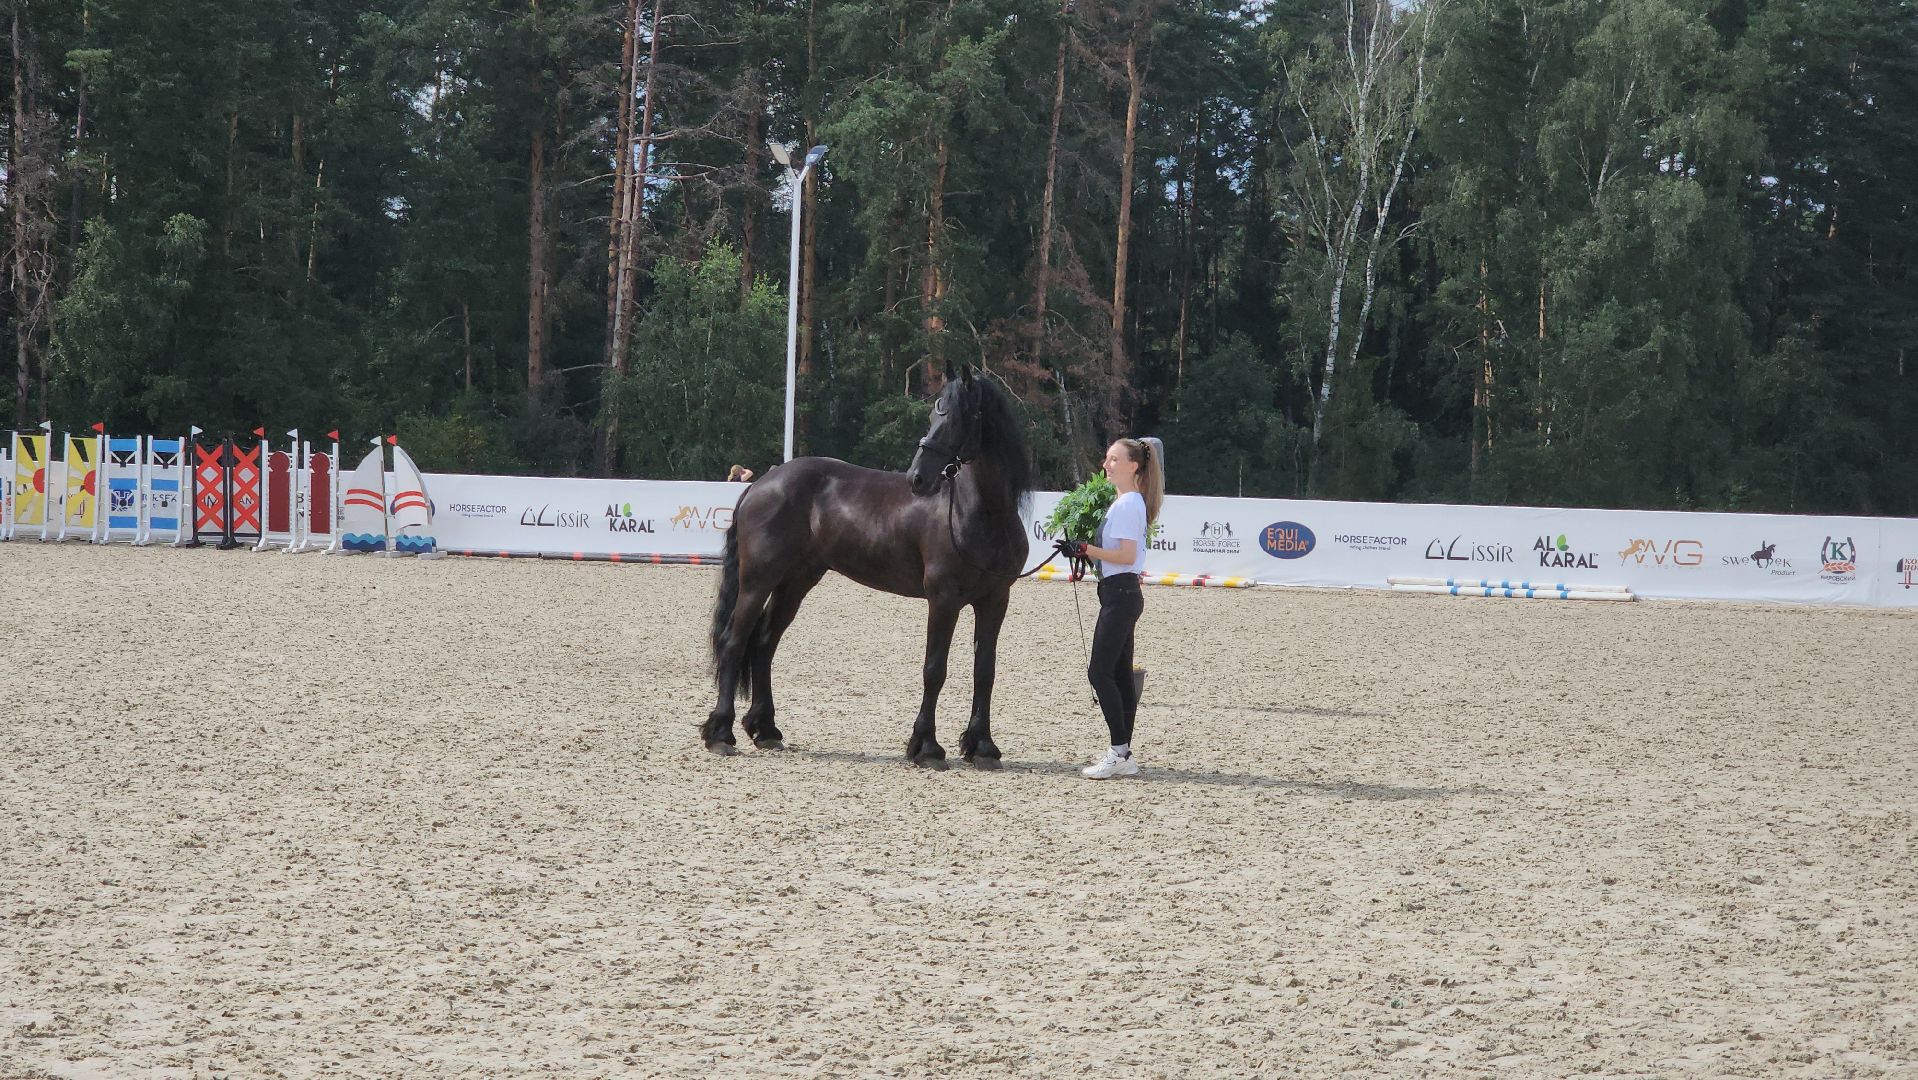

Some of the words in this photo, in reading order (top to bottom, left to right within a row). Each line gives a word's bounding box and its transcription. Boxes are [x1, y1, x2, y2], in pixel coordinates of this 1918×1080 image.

[449, 504, 507, 514] HORSEFACTOR
[605, 504, 622, 517] AL
[609, 518, 655, 533] KARAL
[1267, 527, 1298, 540] EQUI
[1334, 535, 1407, 545] HORSEFACTOR
[1267, 539, 1307, 551] MEDIA
[1533, 536, 1556, 551] AL
[1540, 552, 1598, 568] KARAL
